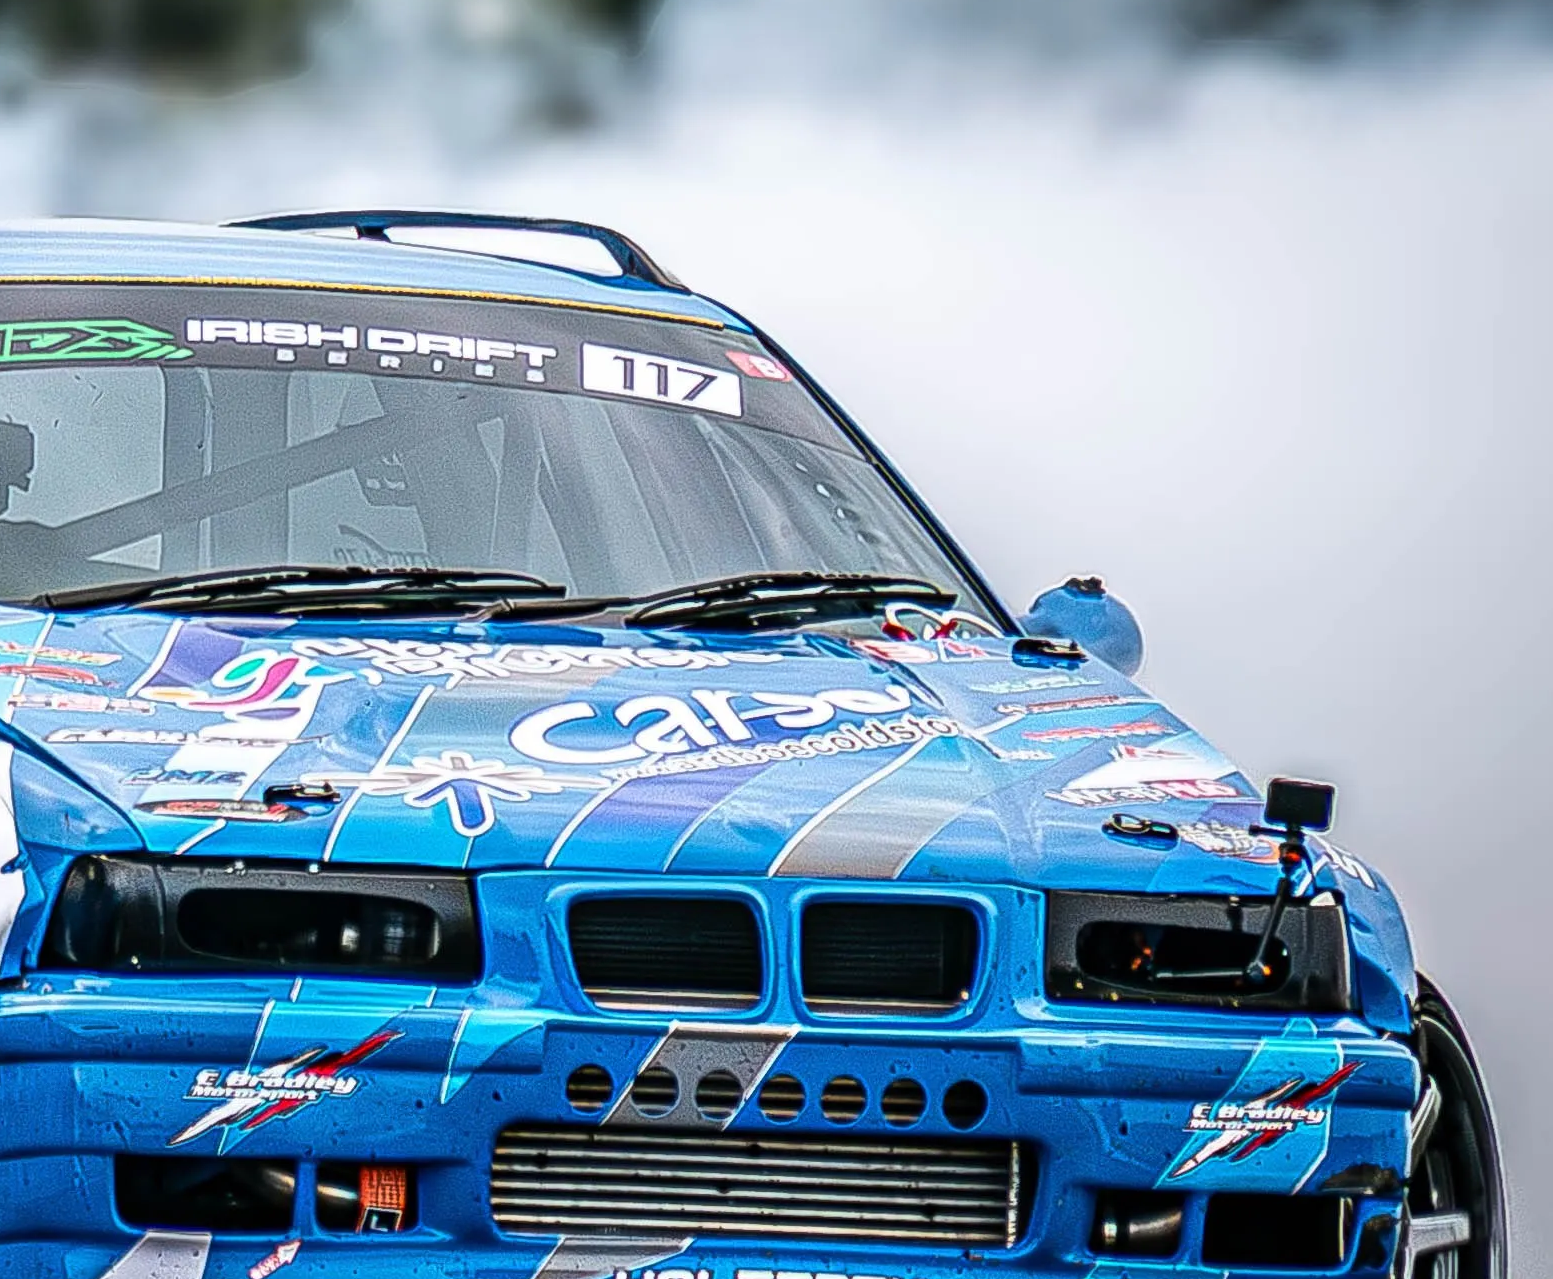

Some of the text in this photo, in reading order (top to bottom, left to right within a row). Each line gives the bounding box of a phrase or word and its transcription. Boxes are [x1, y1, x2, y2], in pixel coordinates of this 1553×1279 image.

[186, 319, 558, 367] IRISH DRIFT
[612, 355, 719, 402] 117
[225, 1070, 358, 1094] Bradley
[1217, 1104, 1326, 1124] Bradley
